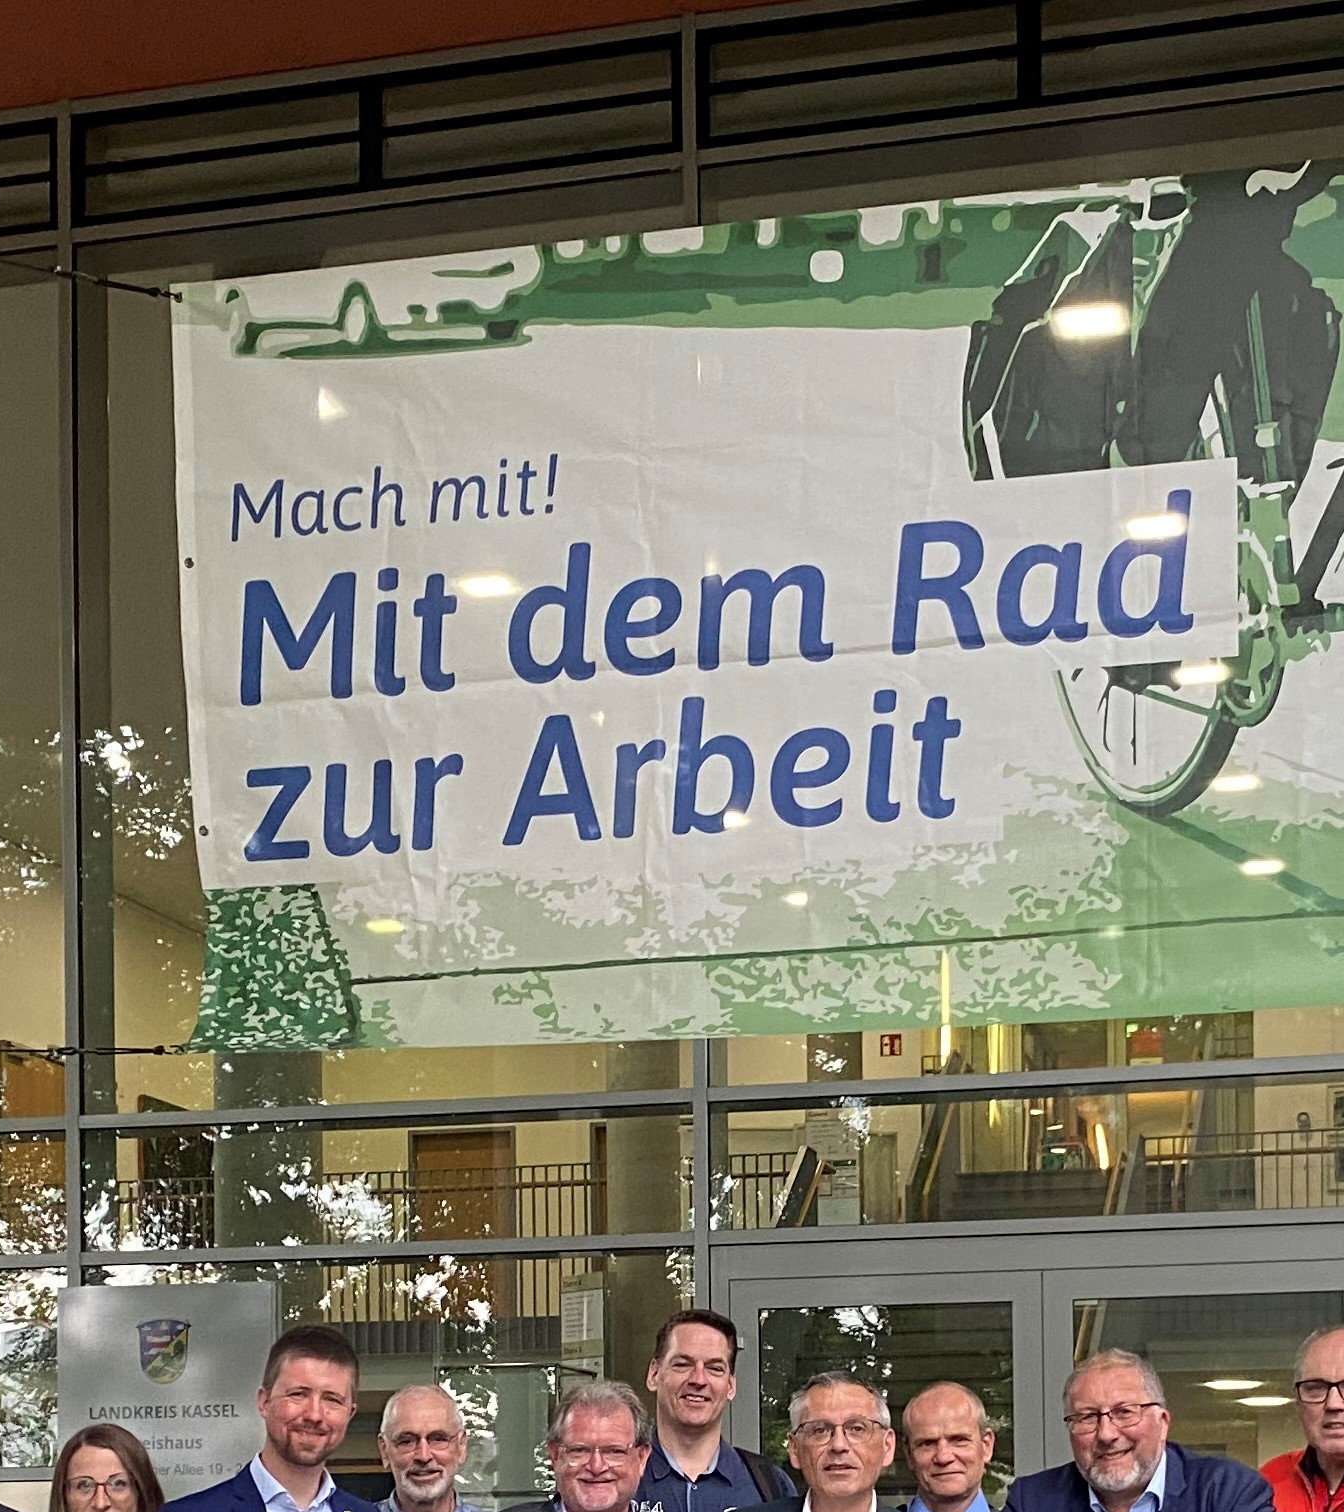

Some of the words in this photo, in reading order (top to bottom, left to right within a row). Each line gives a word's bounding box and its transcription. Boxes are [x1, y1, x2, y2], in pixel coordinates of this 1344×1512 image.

[231, 467, 406, 543] Mach
[429, 453, 559, 525] mit!
[240, 568, 458, 706] Mit
[508, 543, 833, 684] dem
[892, 490, 1194, 655] Rad
[243, 750, 463, 861] zur
[503, 689, 961, 846] Arbeit
[89, 1405, 177, 1420] LANDKREIS
[182, 1404, 240, 1418] KASSEL
[143, 1434, 203, 1449] eishaus
[174, 1464, 204, 1476] Allee
[209, 1463, 223, 1475] 19
